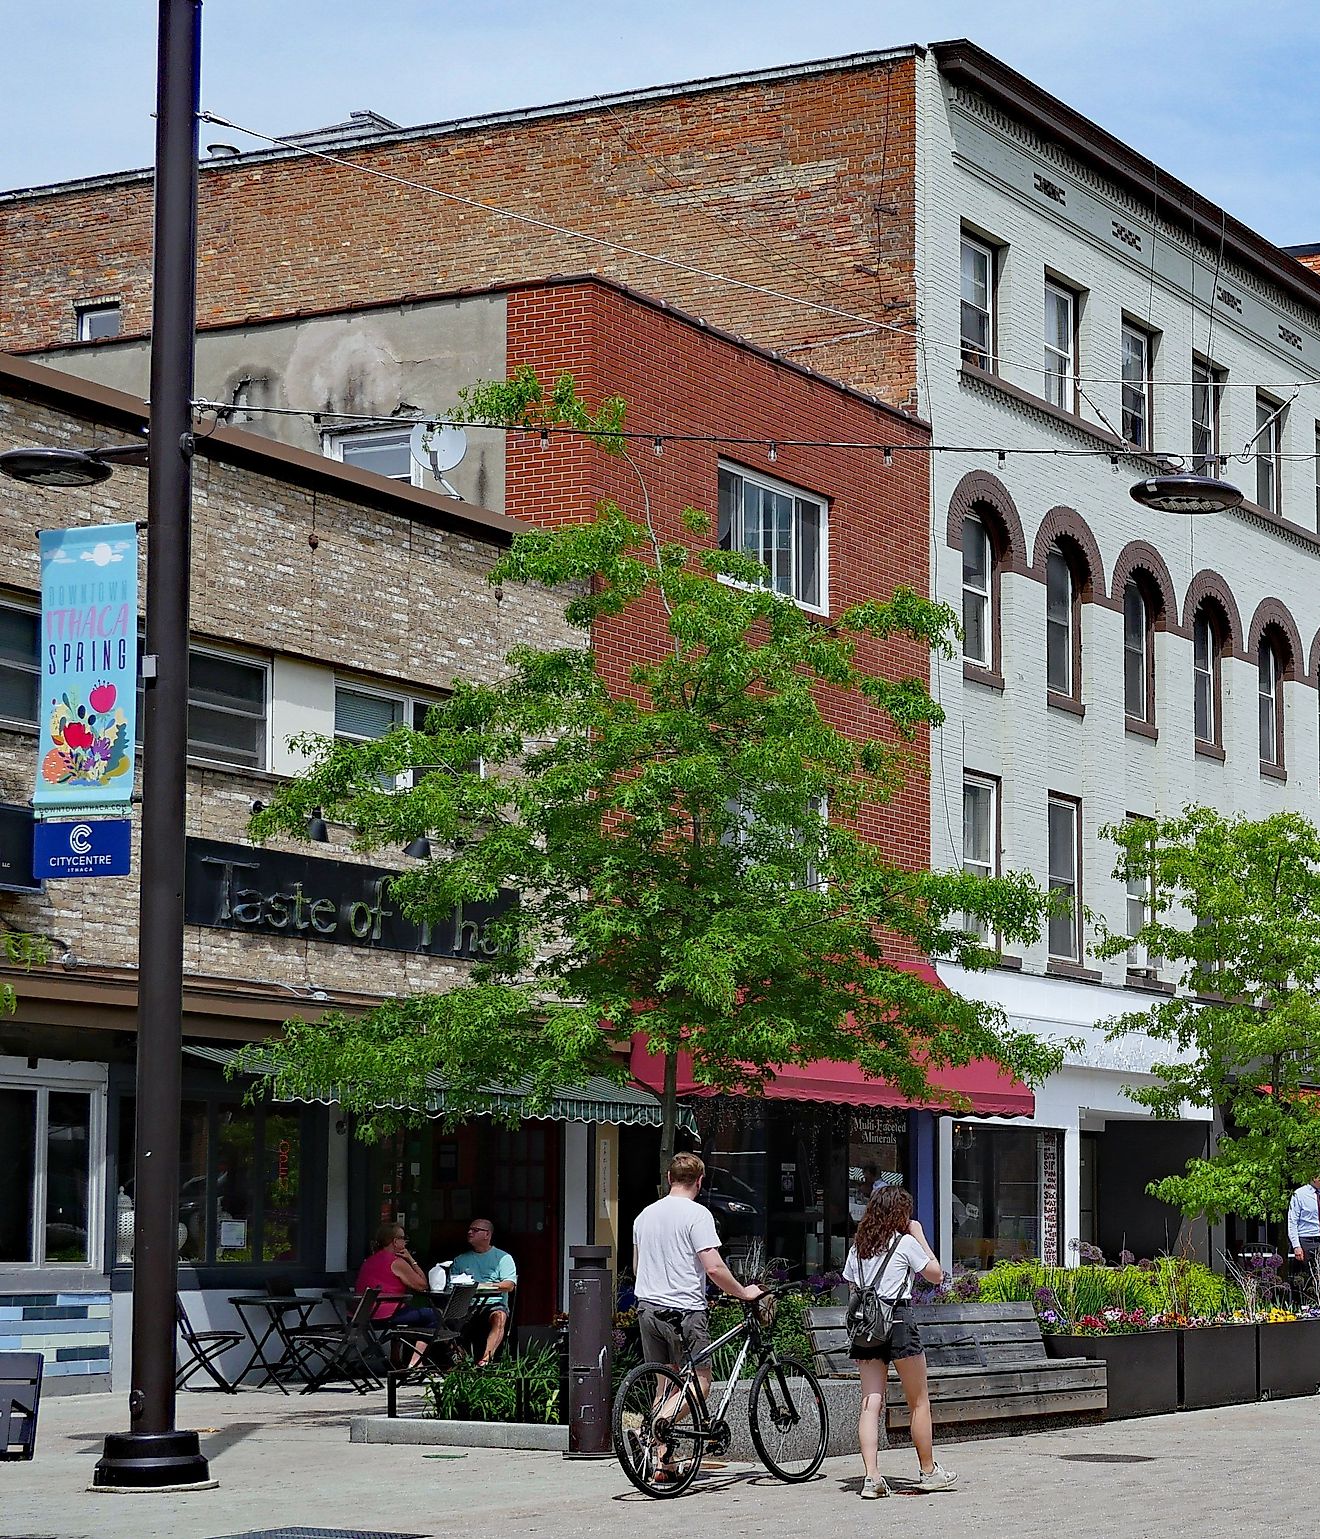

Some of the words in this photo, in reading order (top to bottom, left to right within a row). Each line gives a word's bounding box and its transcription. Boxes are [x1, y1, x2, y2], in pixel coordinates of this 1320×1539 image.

[48, 579, 128, 606] DOWNTOWN
[46, 602, 129, 641] ITHACA
[48, 638, 127, 675] SPRING
[50, 855, 112, 867] CITYCENTRE
[201, 855, 337, 934] Taste
[350, 874, 393, 940] of
[862, 1130, 897, 1144] Minerals
